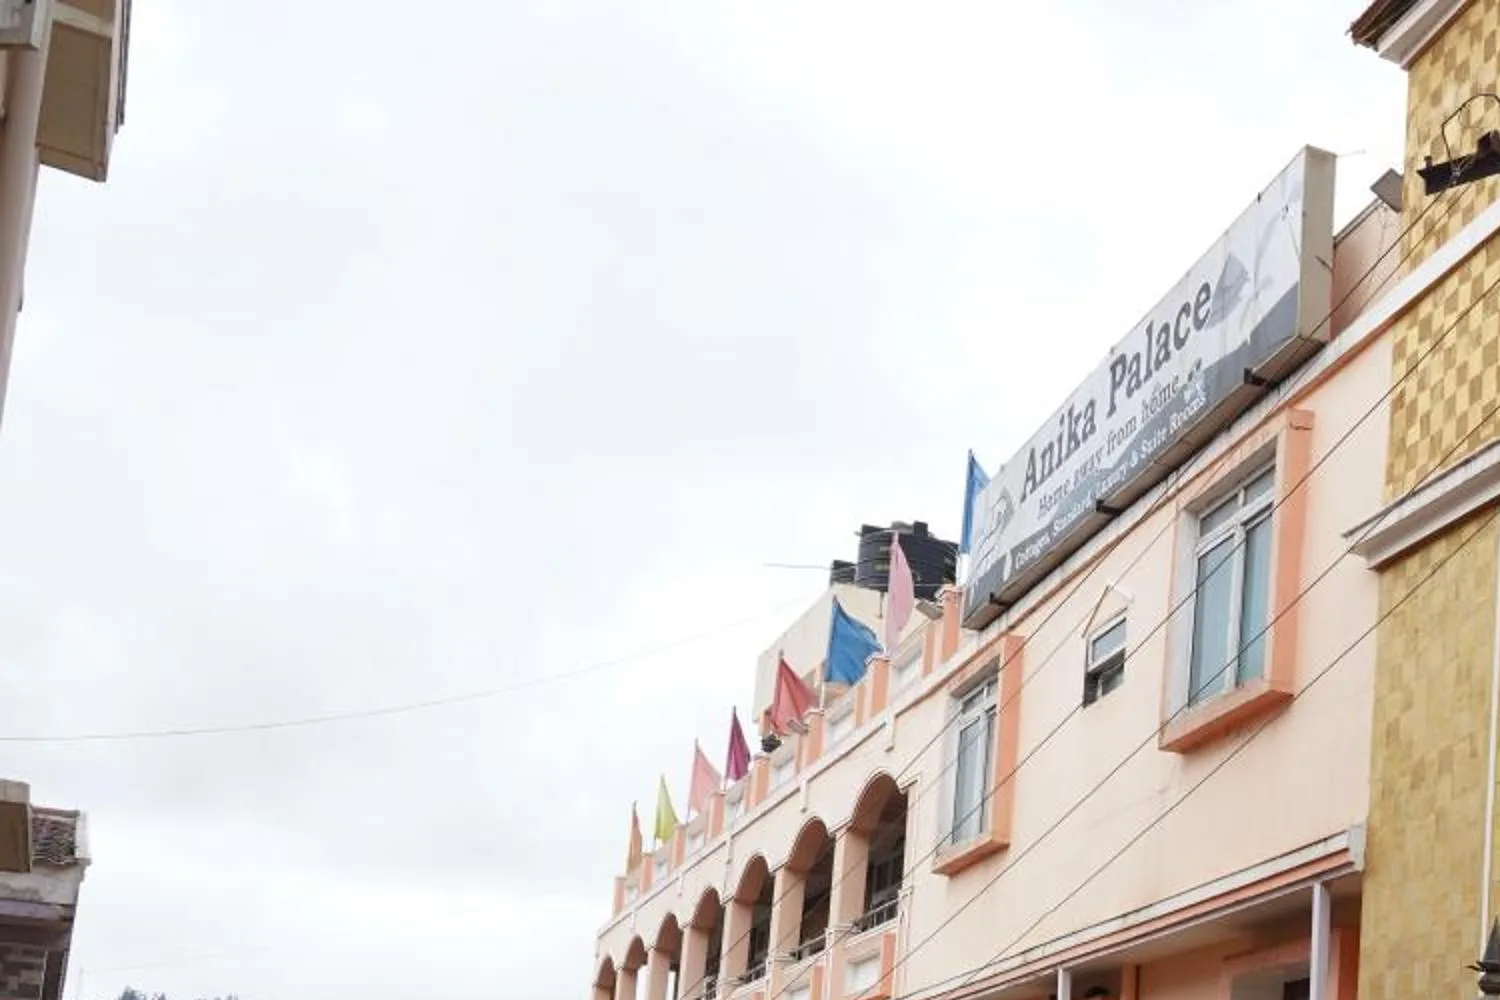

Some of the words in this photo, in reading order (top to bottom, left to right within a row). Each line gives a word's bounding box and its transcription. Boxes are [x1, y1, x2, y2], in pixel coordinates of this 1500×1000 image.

[1020, 396, 1097, 503] Anika
[1106, 281, 1212, 419] Palace
[1105, 414, 1138, 456] from
